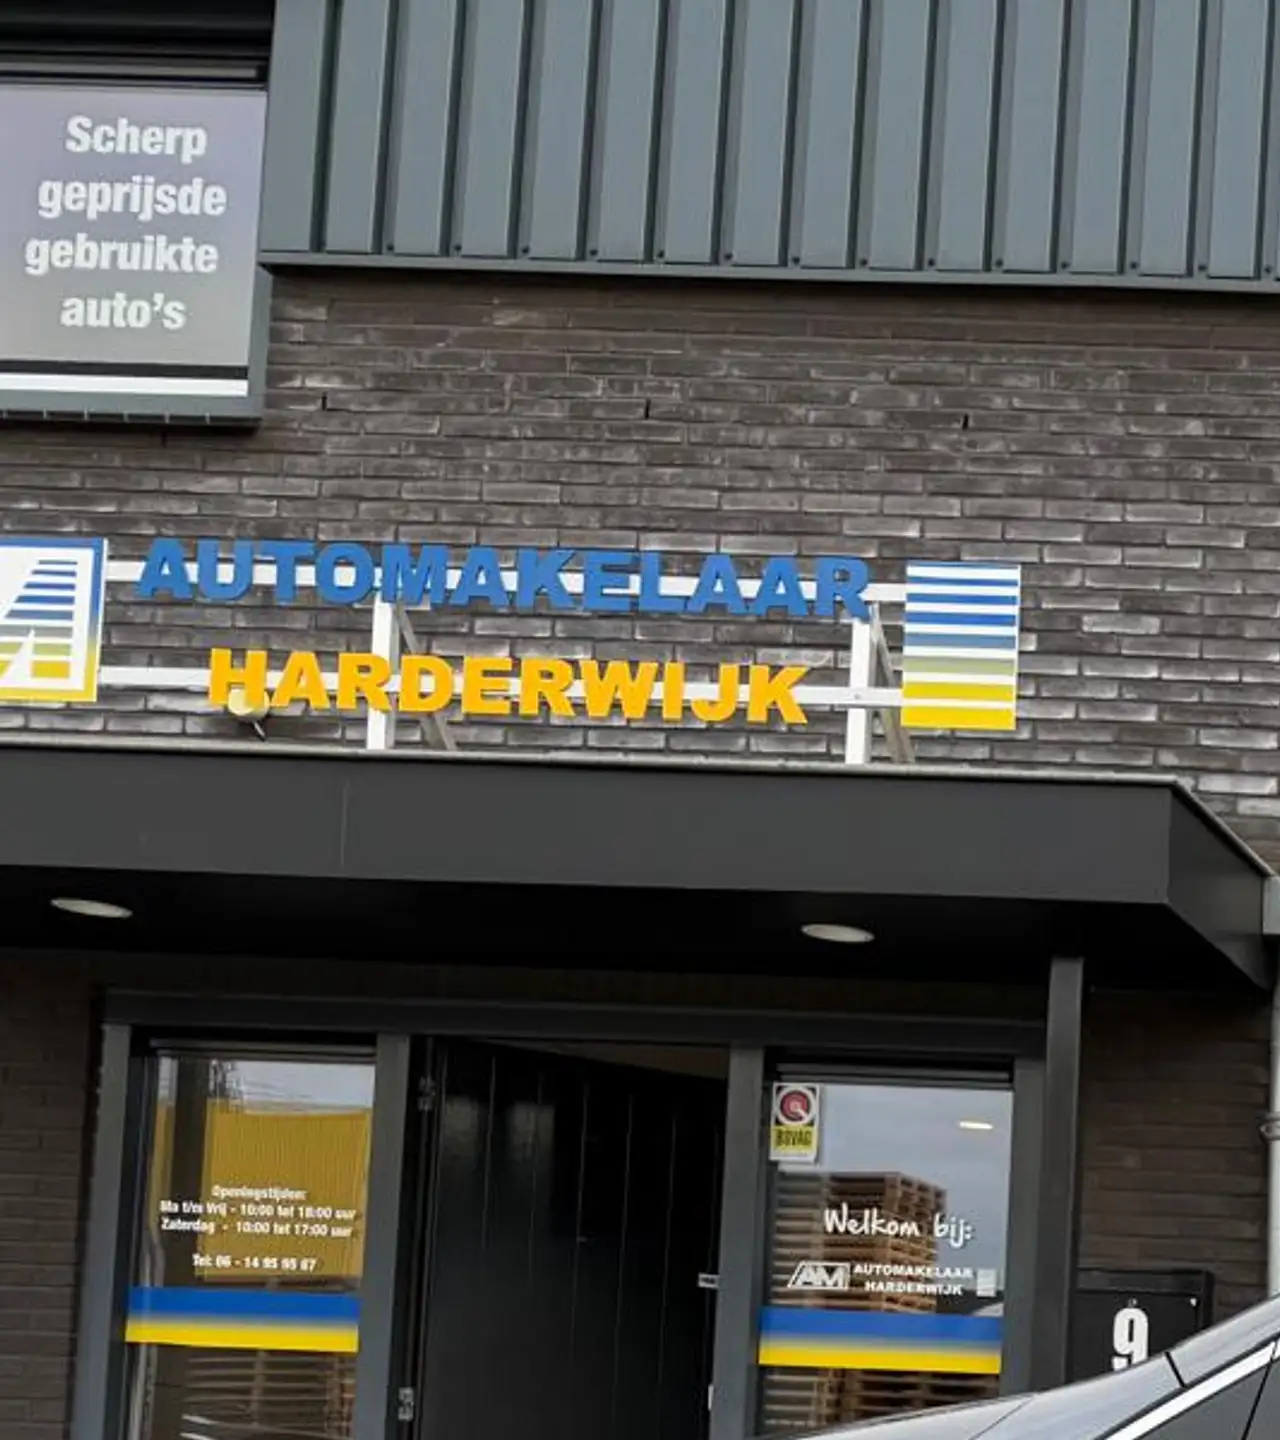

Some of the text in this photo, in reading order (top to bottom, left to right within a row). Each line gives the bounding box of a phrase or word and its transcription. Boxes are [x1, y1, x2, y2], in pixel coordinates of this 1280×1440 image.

[66, 114, 207, 163] Scherp
[38, 175, 227, 222] geprijsde
[24, 233, 218, 276] gebruikte
[60, 292, 186, 330] auto's
[134, 537, 870, 620] AUTOMAKELAAR
[208, 647, 808, 725] HARDERWIJK
[824, 1203, 973, 1248] Welkom bij:
[853, 1264, 974, 1279] AUTOMAKELAAR
[864, 1282, 964, 1296] HARDERWIJK
[1111, 1307, 1149, 1371] 9
